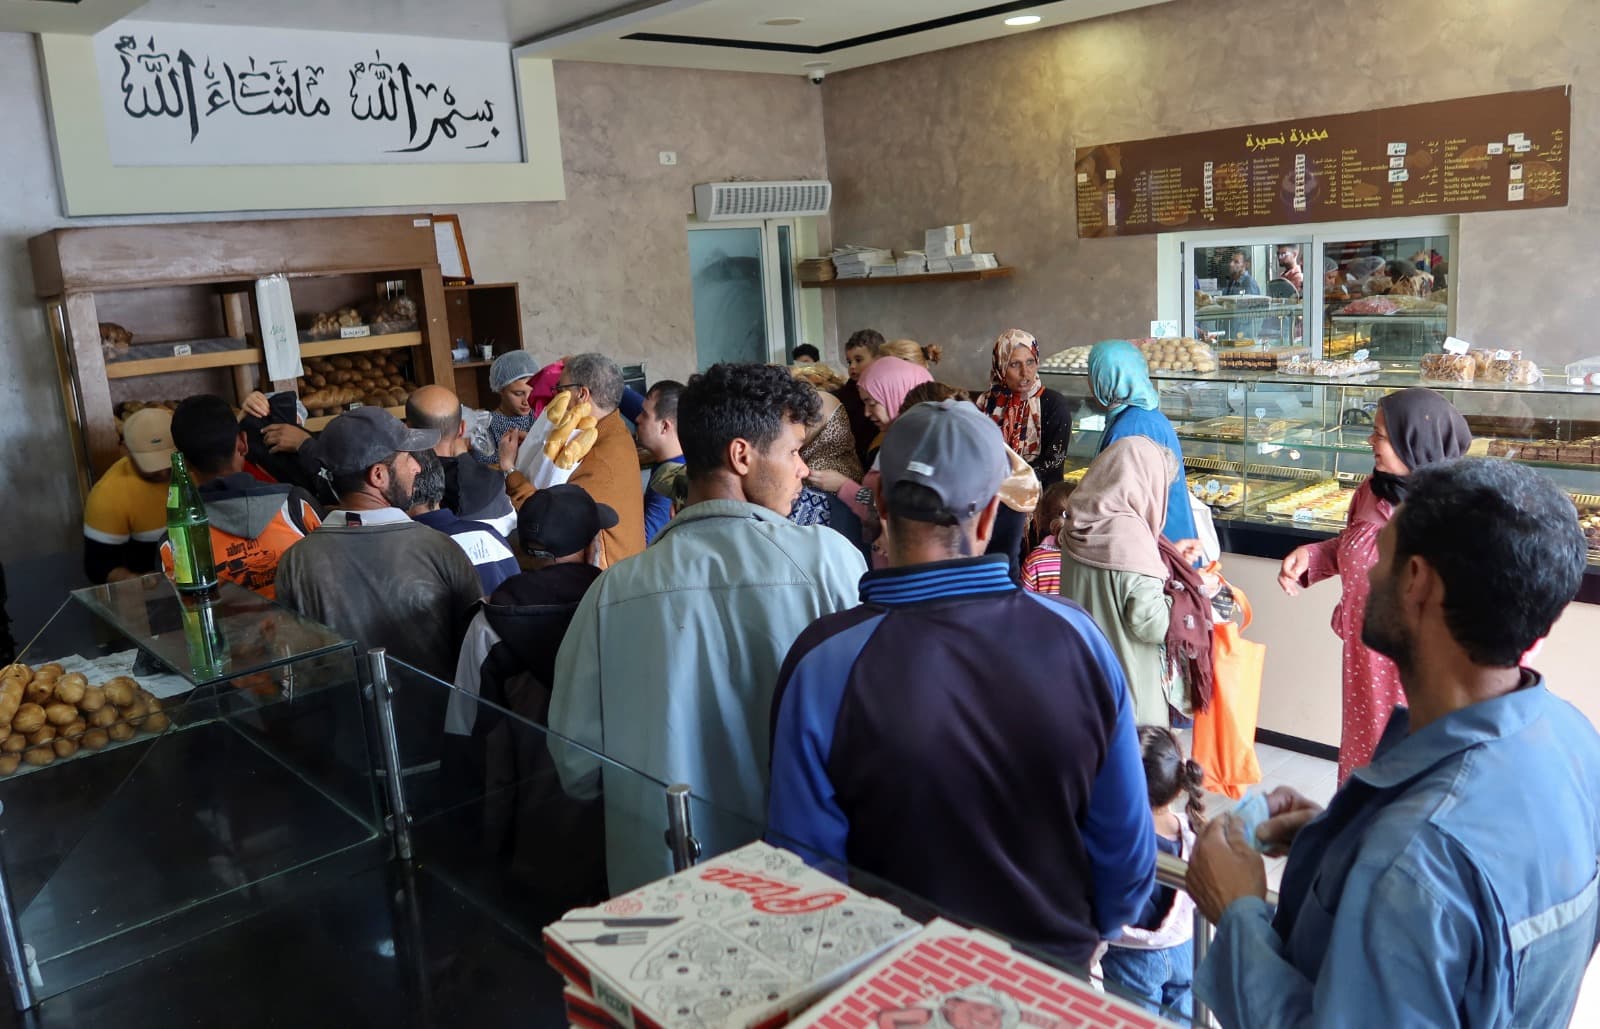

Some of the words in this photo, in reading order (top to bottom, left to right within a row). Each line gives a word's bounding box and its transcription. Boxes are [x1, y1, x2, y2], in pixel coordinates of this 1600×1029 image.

[1245, 132, 1285, 153] نصيرة
[1290, 128, 1329, 148] مخبزة
[699, 868, 847, 914] Pizza
